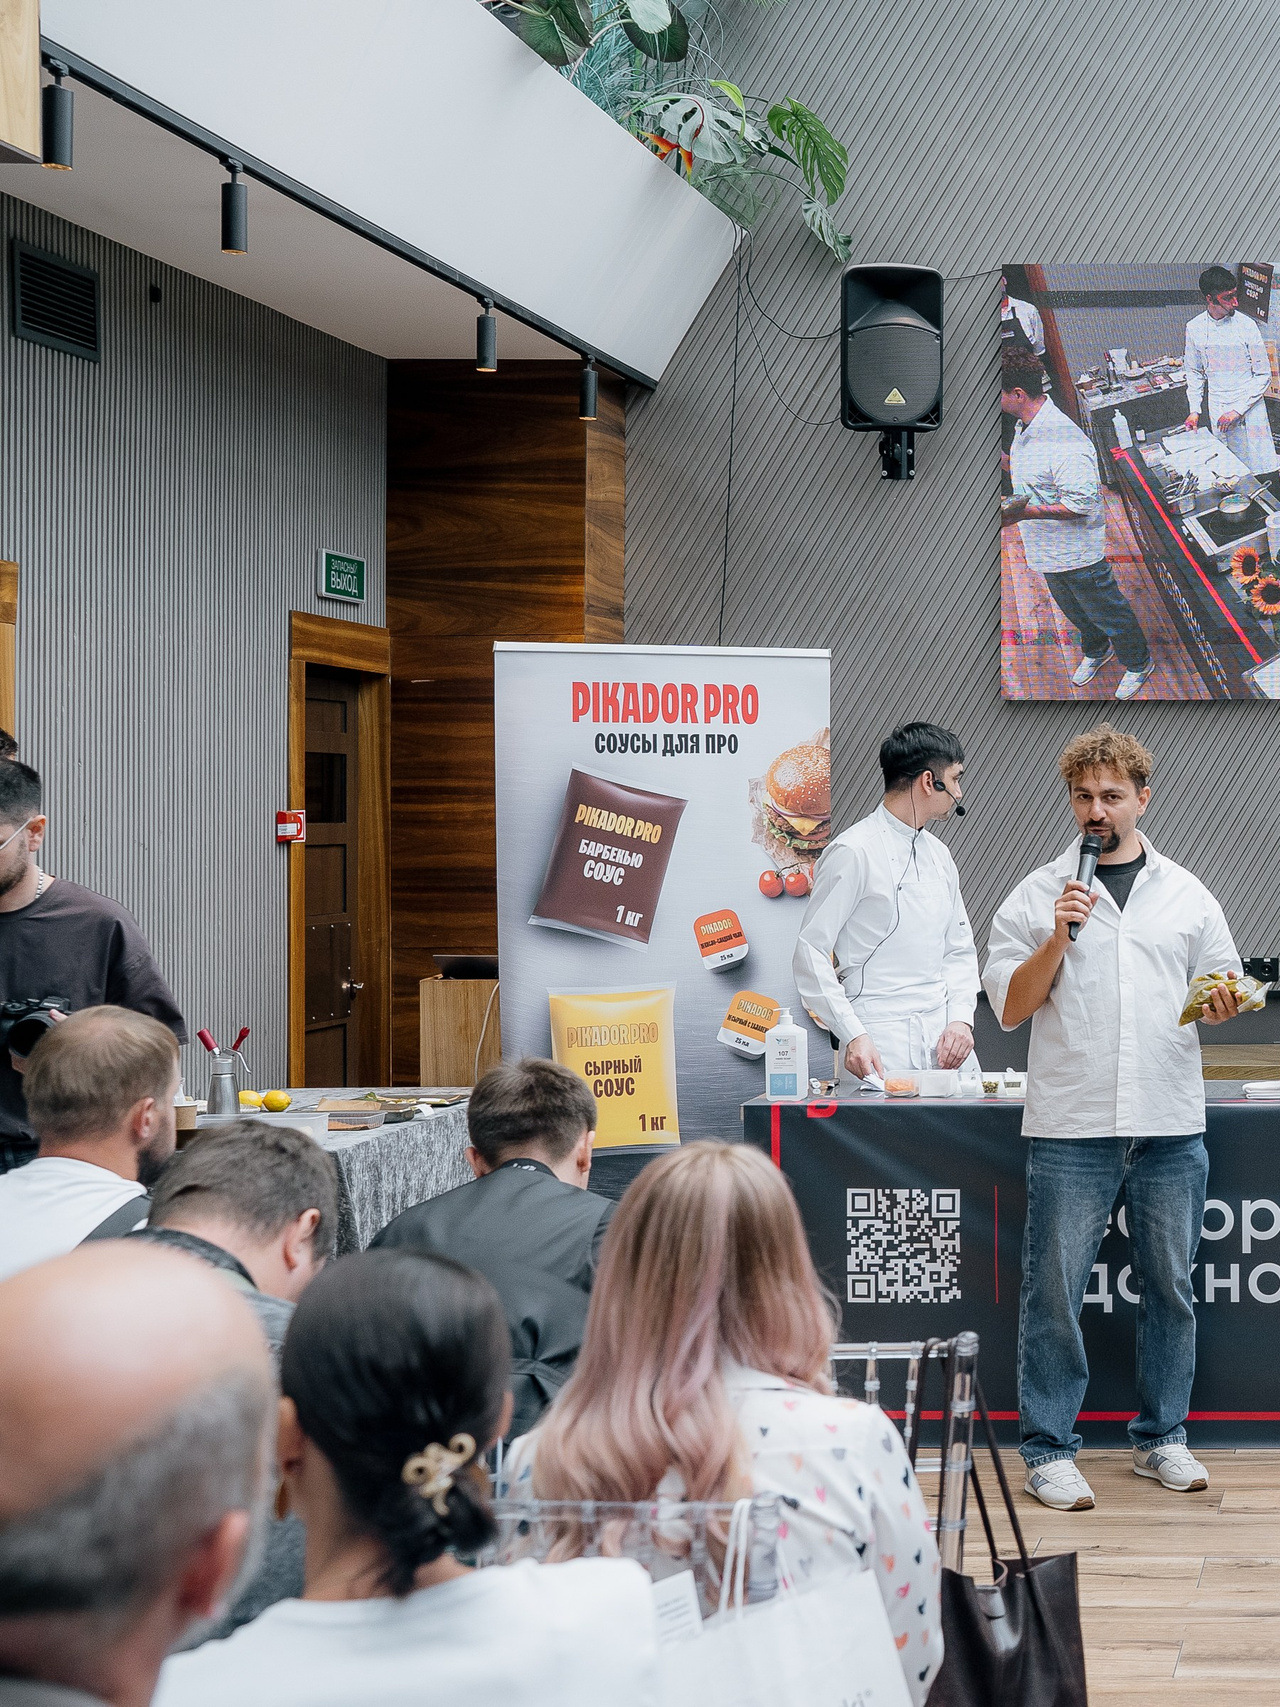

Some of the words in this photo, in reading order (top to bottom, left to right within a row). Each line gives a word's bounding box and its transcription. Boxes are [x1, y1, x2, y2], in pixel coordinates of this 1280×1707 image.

[331, 559, 357, 574] ЗАПАСНЫЙ
[331, 570, 358, 596] ВЫХОД
[572, 681, 699, 724] PIKADOR
[703, 683, 759, 725] PRO
[594, 732, 658, 755] СОУСЫ
[661, 733, 700, 757] ДЛЯ
[705, 733, 739, 755] ПРО
[574, 803, 636, 837] PIKADOR
[633, 819, 662, 844] PRO
[583, 859, 625, 886] СОУС
[616, 904, 625, 923] 1
[700, 918, 734, 936] PIKADOR
[737, 999, 774, 1021] PIKADOR
[567, 1024, 629, 1048] PIKADOR
[630, 1022, 659, 1044] PRO
[584, 1055, 642, 1076] СЫРНЫЙ
[593, 1077, 635, 1098] СОУС
[639, 1113, 646, 1132] 1
